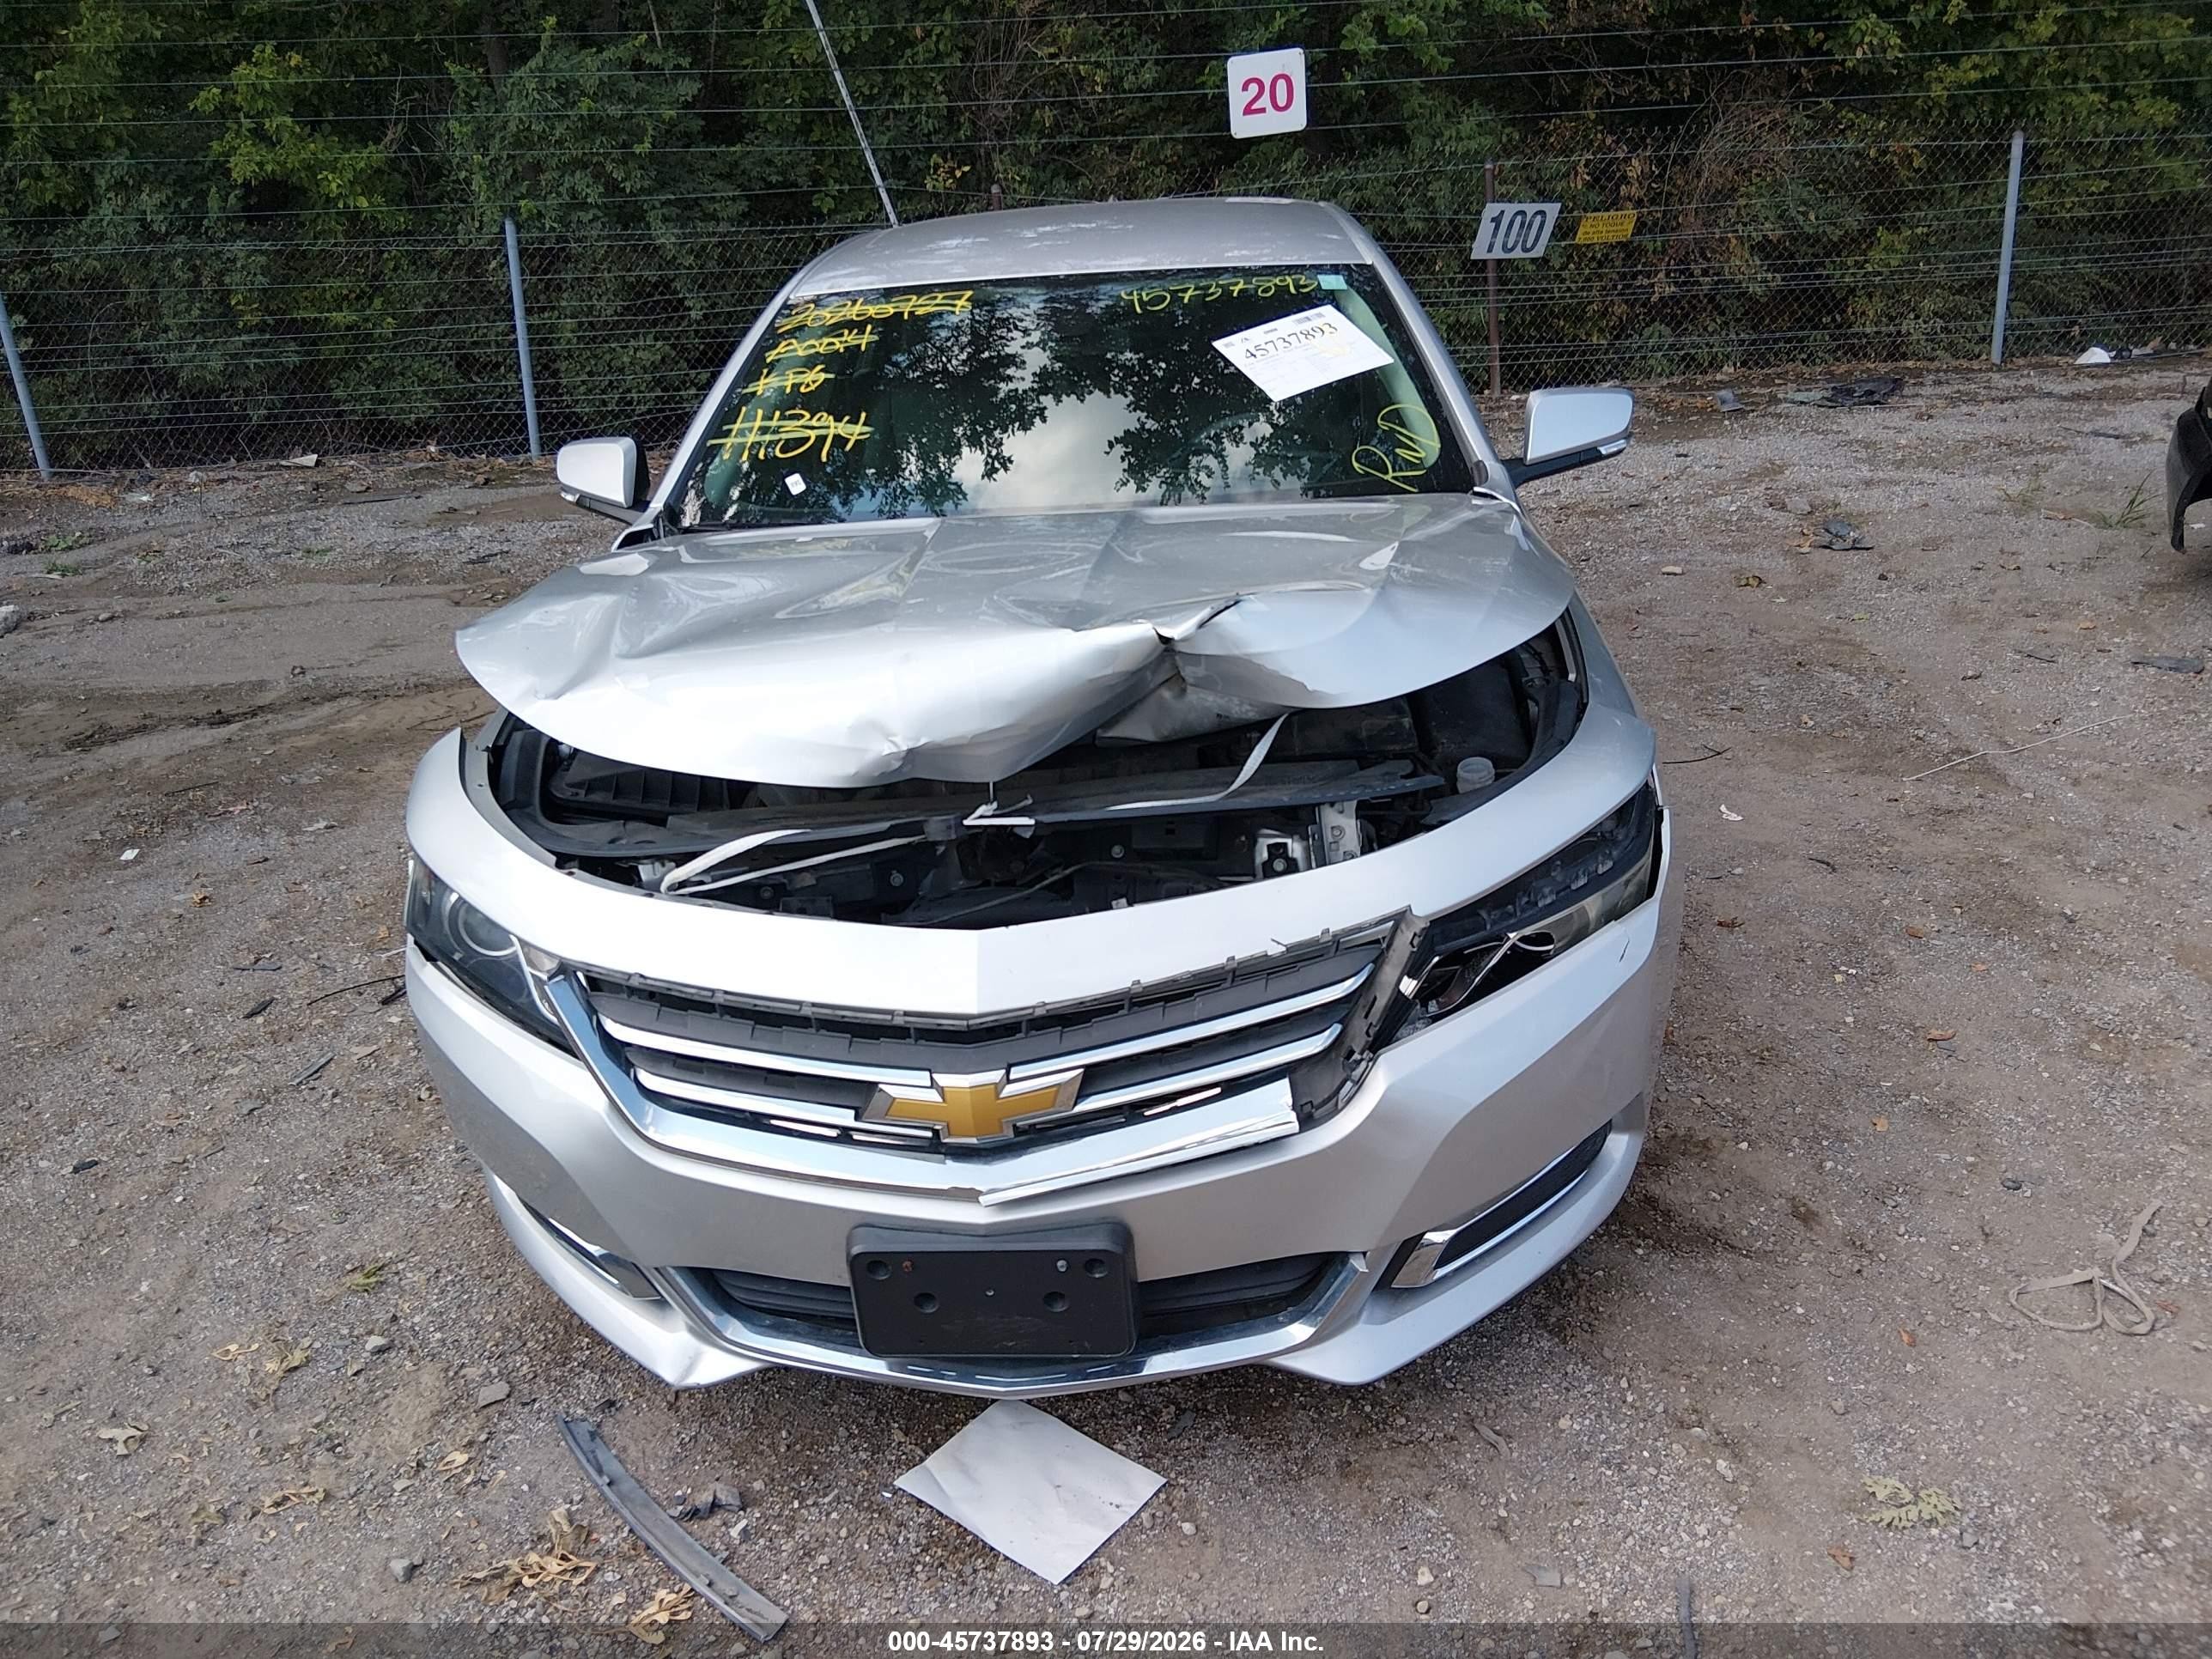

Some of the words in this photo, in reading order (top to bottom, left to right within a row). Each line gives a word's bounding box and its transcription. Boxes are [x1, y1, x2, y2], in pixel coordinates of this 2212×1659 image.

[1241, 73, 1295, 117] 20
[1486, 210, 1547, 254] 100
[1584, 213, 1636, 222] PELIGRO
[1121, 274, 1319, 314] 45737893
[1244, 322, 1339, 360] 45737893
